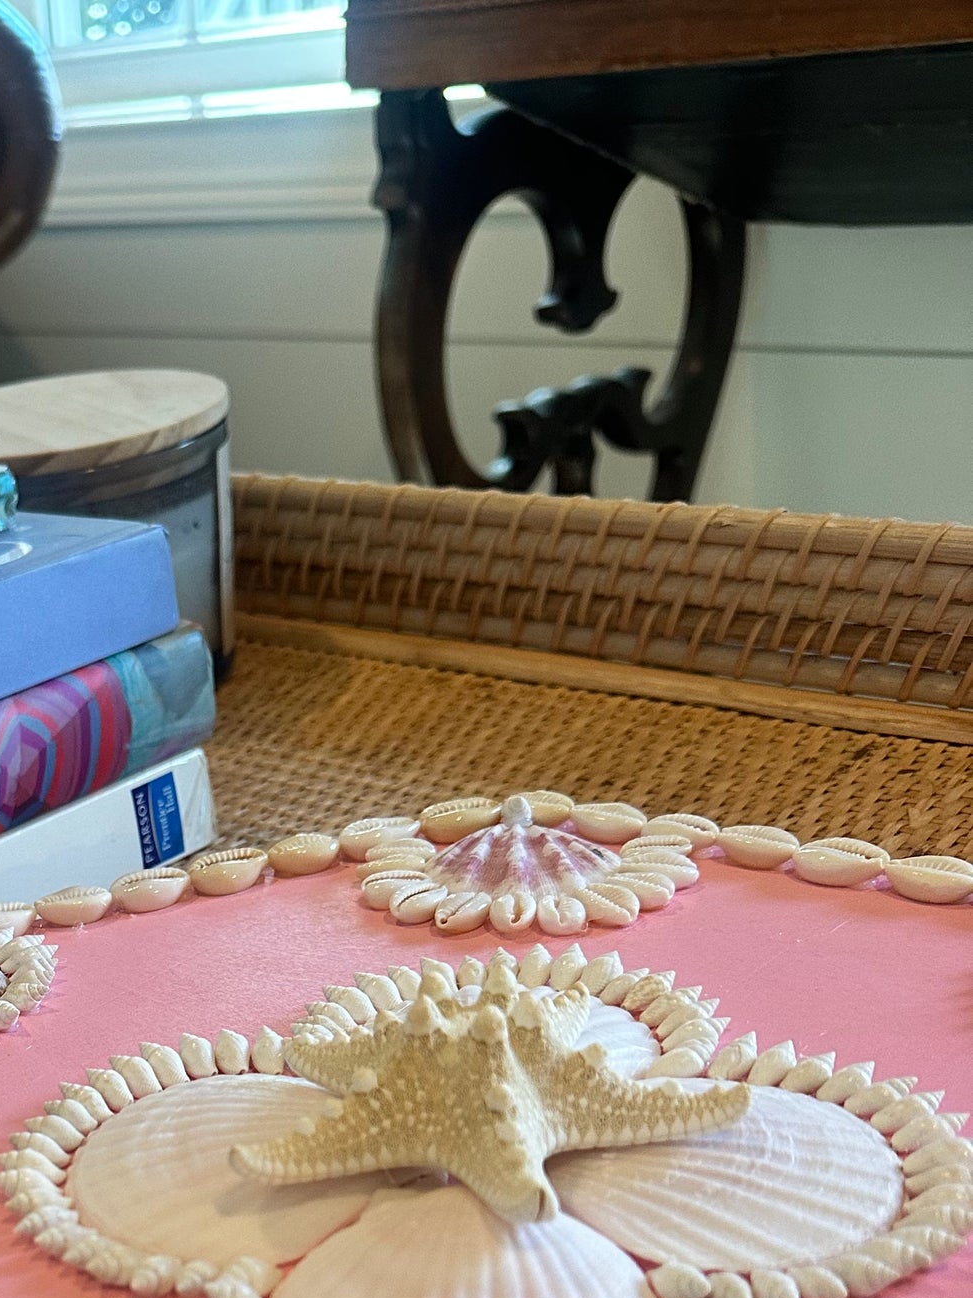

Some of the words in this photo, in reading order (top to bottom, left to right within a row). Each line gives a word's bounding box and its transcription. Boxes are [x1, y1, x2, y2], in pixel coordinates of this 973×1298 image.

[157, 798, 172, 852] Prentice
[162, 785, 176, 814] Hall
[135, 792, 156, 864] PEARSON
